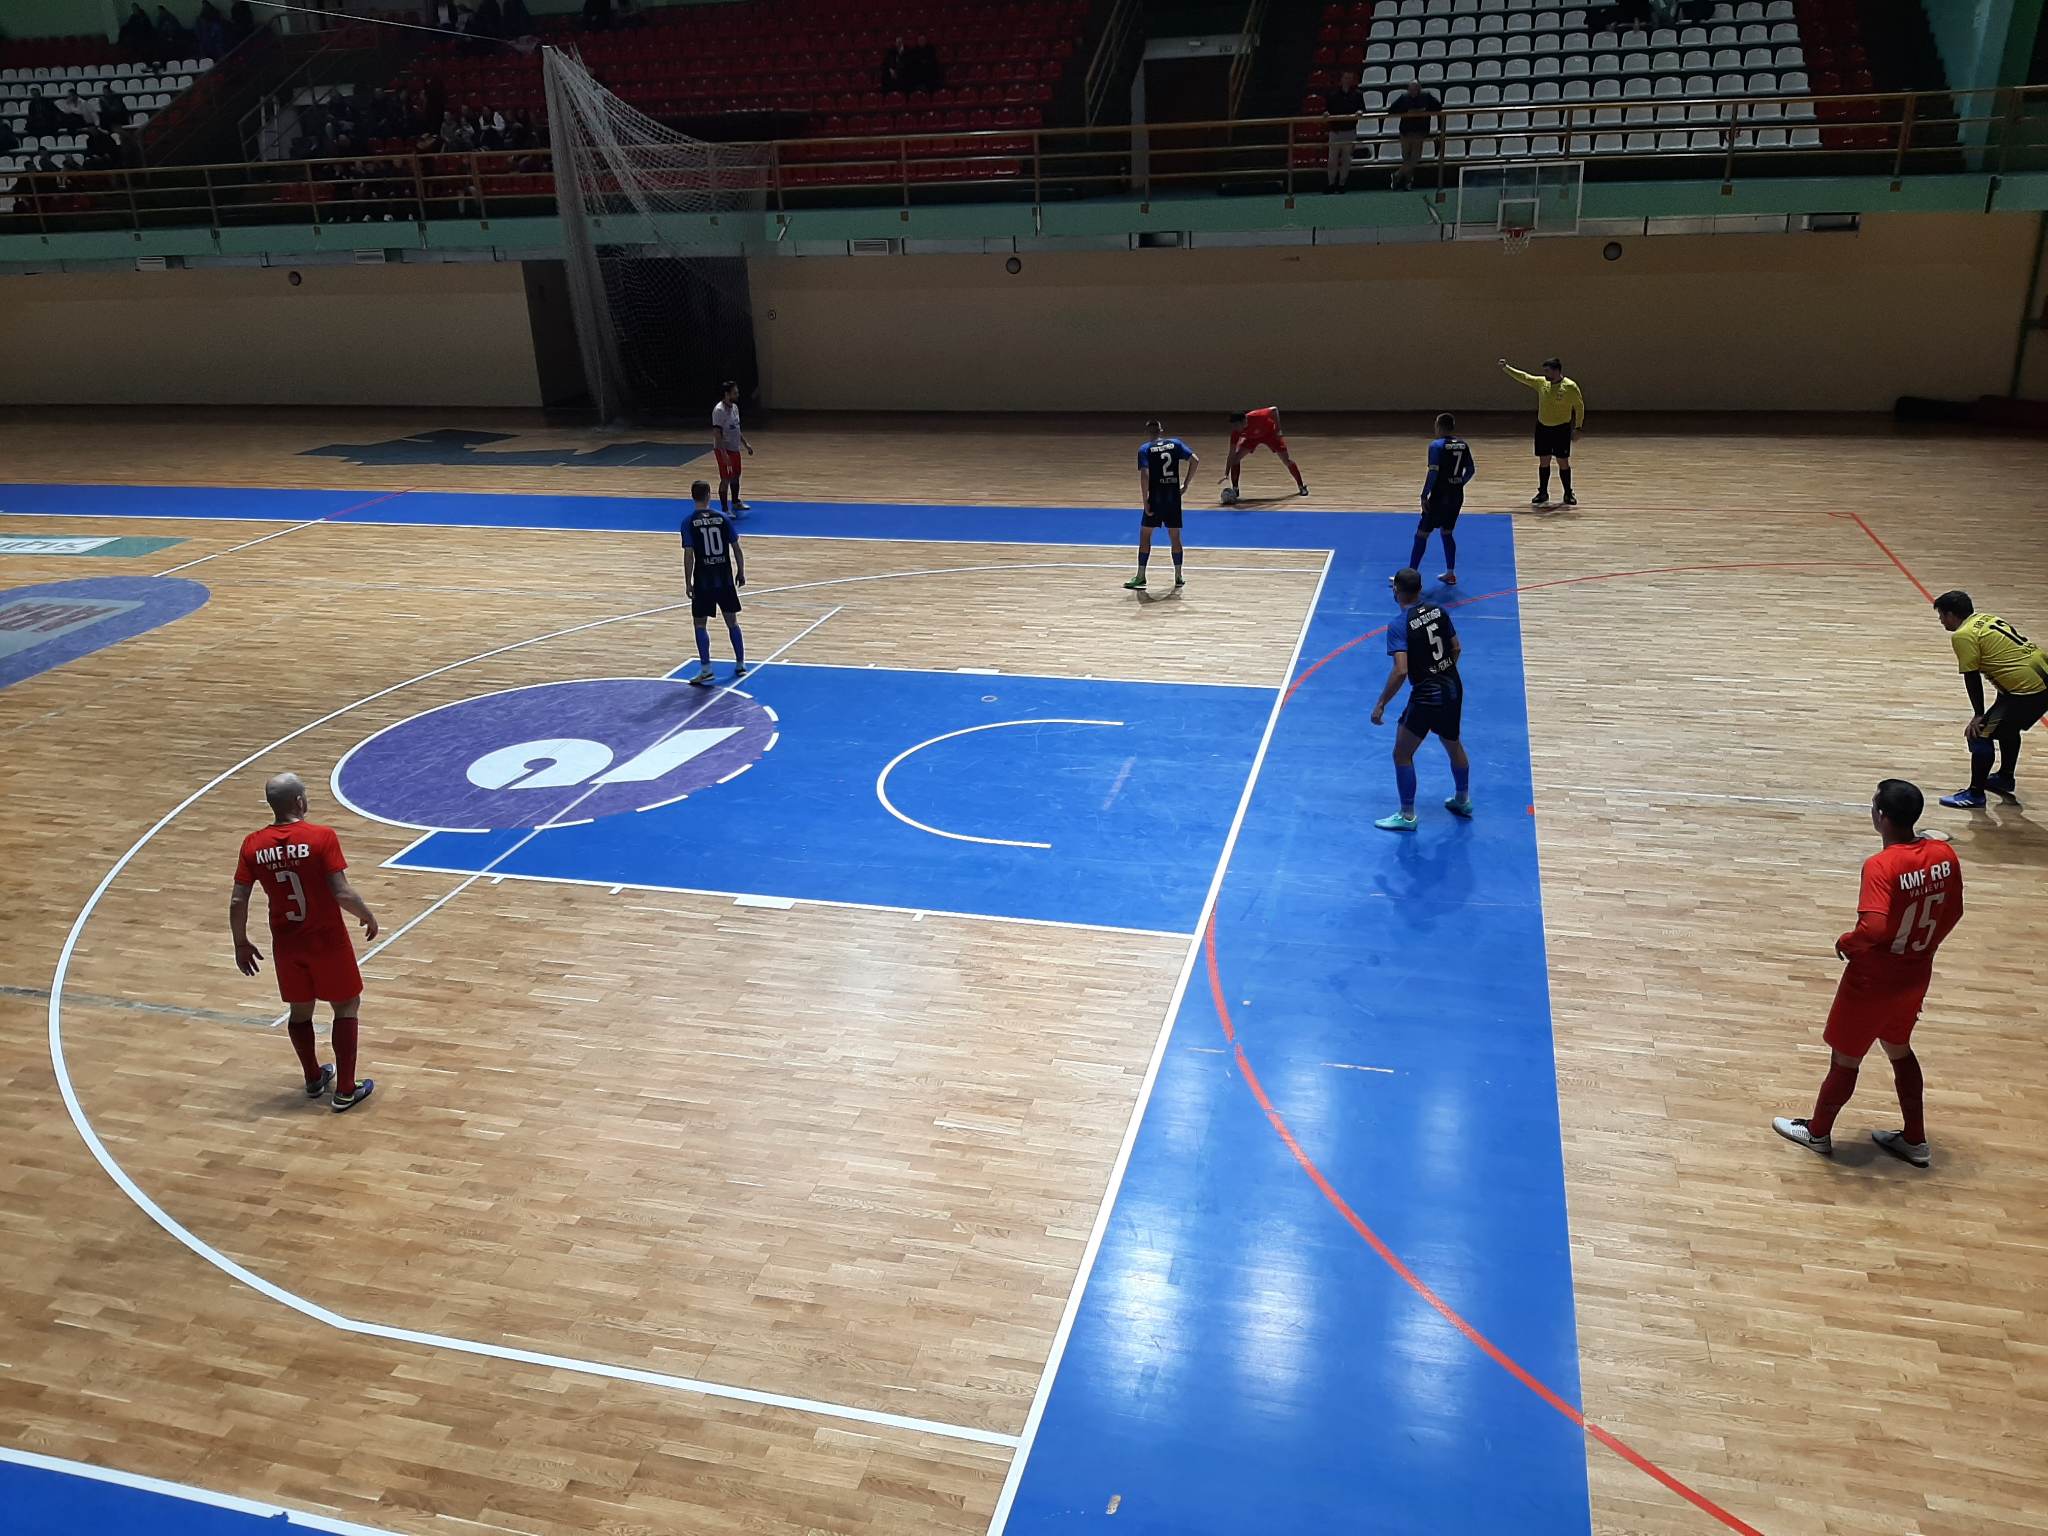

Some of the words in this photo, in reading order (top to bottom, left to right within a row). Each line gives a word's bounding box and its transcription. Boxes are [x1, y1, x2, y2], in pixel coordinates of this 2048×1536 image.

[1160, 452, 1172, 477] 2
[1453, 451, 1462, 476] 7
[700, 526, 723, 556] 10
[1426, 622, 1443, 661] 5
[1989, 619, 2029, 646] 12
[255, 846, 285, 865] KMF
[286, 843, 310, 860] RB
[1899, 868, 1926, 890] KMF
[1930, 861, 1951, 881] RB
[275, 870, 306, 922] 3
[1890, 892, 1945, 954] 15
